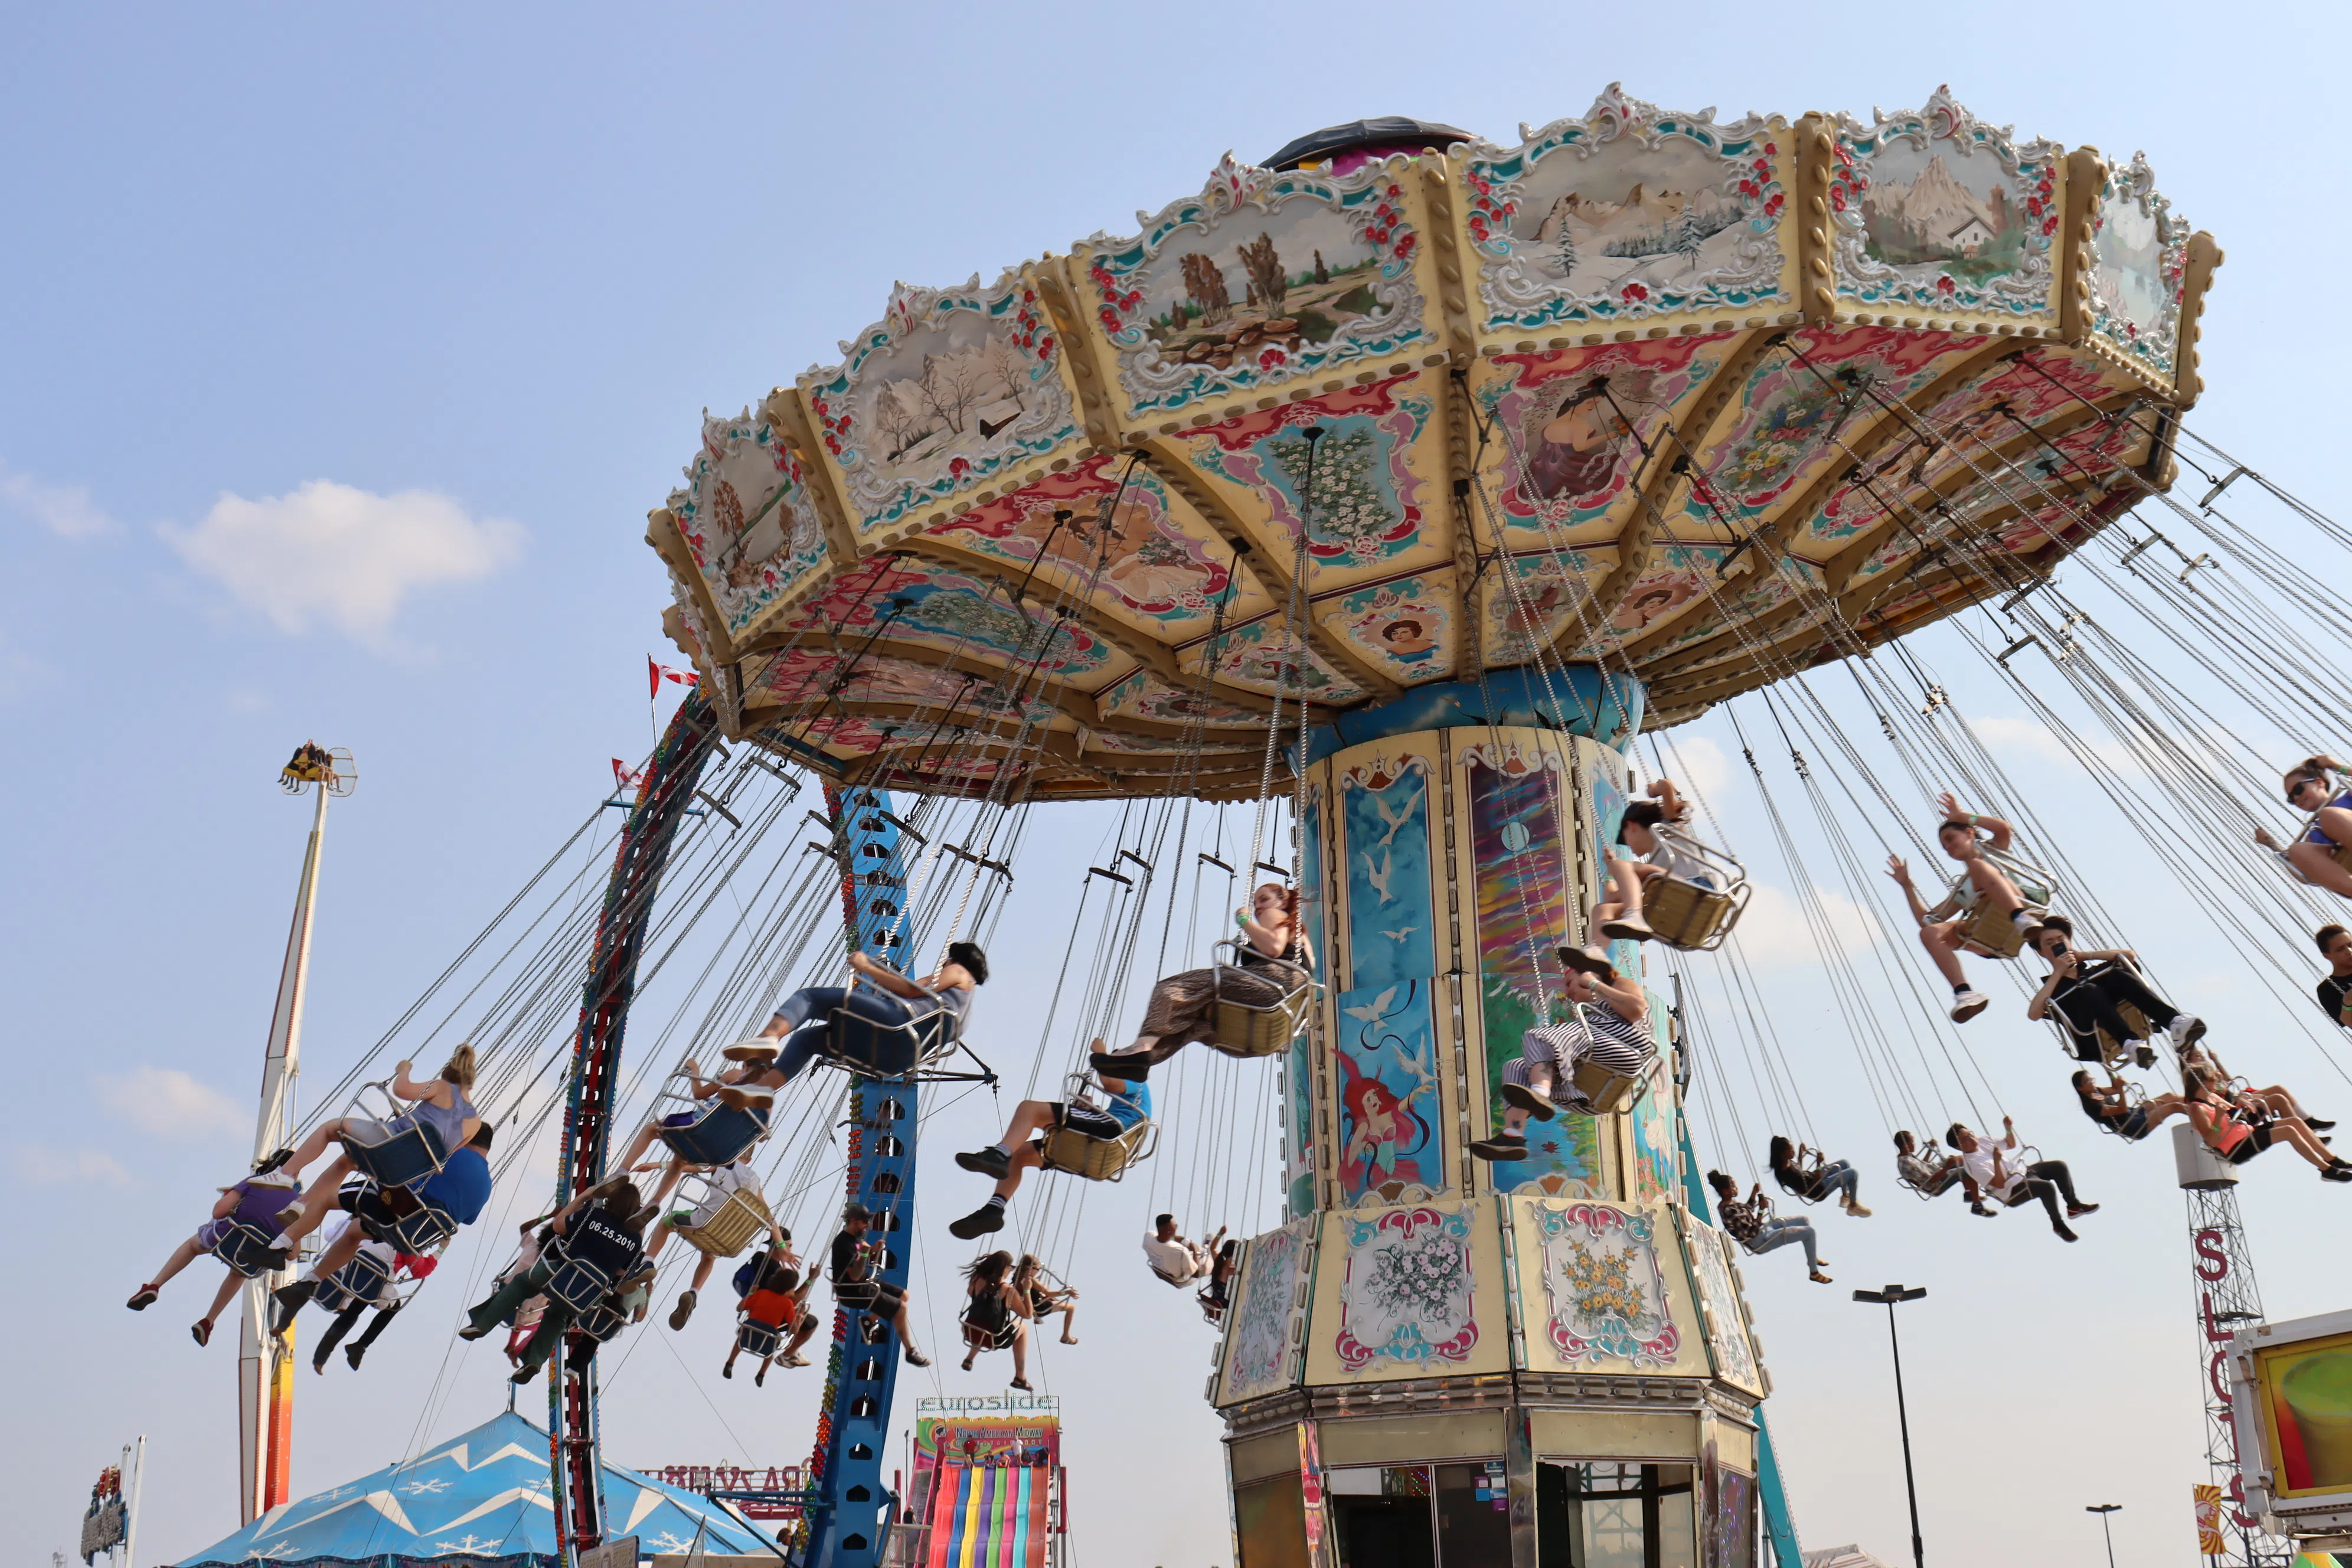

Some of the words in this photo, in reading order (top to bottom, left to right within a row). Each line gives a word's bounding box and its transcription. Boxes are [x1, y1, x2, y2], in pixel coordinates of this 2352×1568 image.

[588, 1220, 636, 1252] 06.25.2010
[920, 1389, 1053, 1412] euroslide
[980, 1426, 1014, 1439] AMERICAN
[1015, 1425, 1044, 1439] MIDWAY
